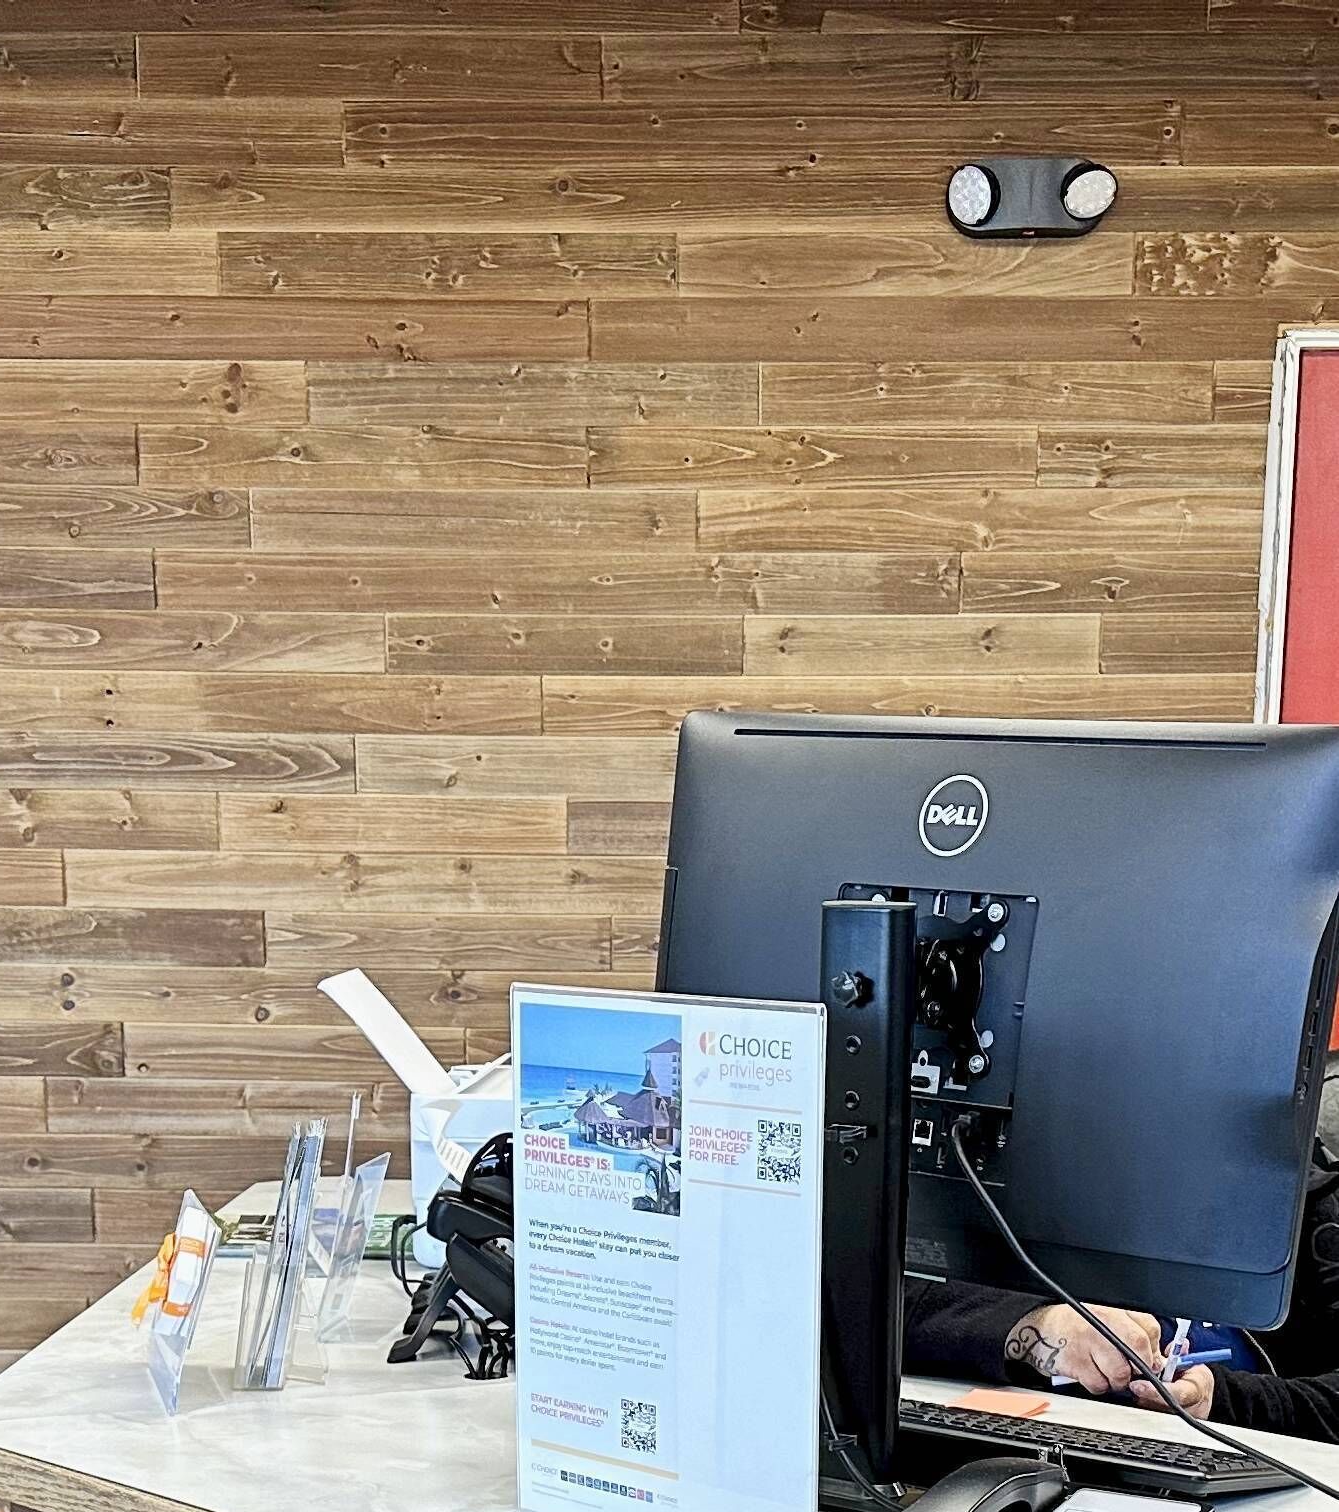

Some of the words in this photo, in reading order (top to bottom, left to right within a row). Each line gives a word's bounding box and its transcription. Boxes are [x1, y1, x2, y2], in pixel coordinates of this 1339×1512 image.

[927, 804, 978, 826] DELL
[719, 1034, 792, 1060] CHOICE
[719, 1061, 792, 1086] privileges
[524, 1134, 565, 1149] CHOICE
[689, 1125, 712, 1137] JOIN
[715, 1128, 753, 1142] CHOICE
[596, 1158, 611, 1171] IS:
[689, 1151, 709, 1162] FOR
[712, 1153, 739, 1166] FREE.
[524, 1163, 574, 1181] TURNING
[578, 1170, 611, 1186] STAYS
[615, 1176, 642, 1190] INTO
[524, 1178, 564, 1195] DREAM
[569, 1184, 629, 1204] GETAWAYS
[529, 1218, 548, 1229] When
[579, 1227, 601, 1237] Choice
[604, 1231, 637, 1244] Privileges
[543, 1244, 564, 1254] dream
[549, 1234, 571, 1244] Choice
[599, 1242, 613, 1252] stay
[644, 1250, 656, 1258] you
[659, 1251, 679, 1262] closer
[531, 1393, 553, 1406] START
[554, 1398, 586, 1413] EARNING
[588, 1406, 608, 1418] WITH
[531, 1404, 558, 1418] CHOICE
